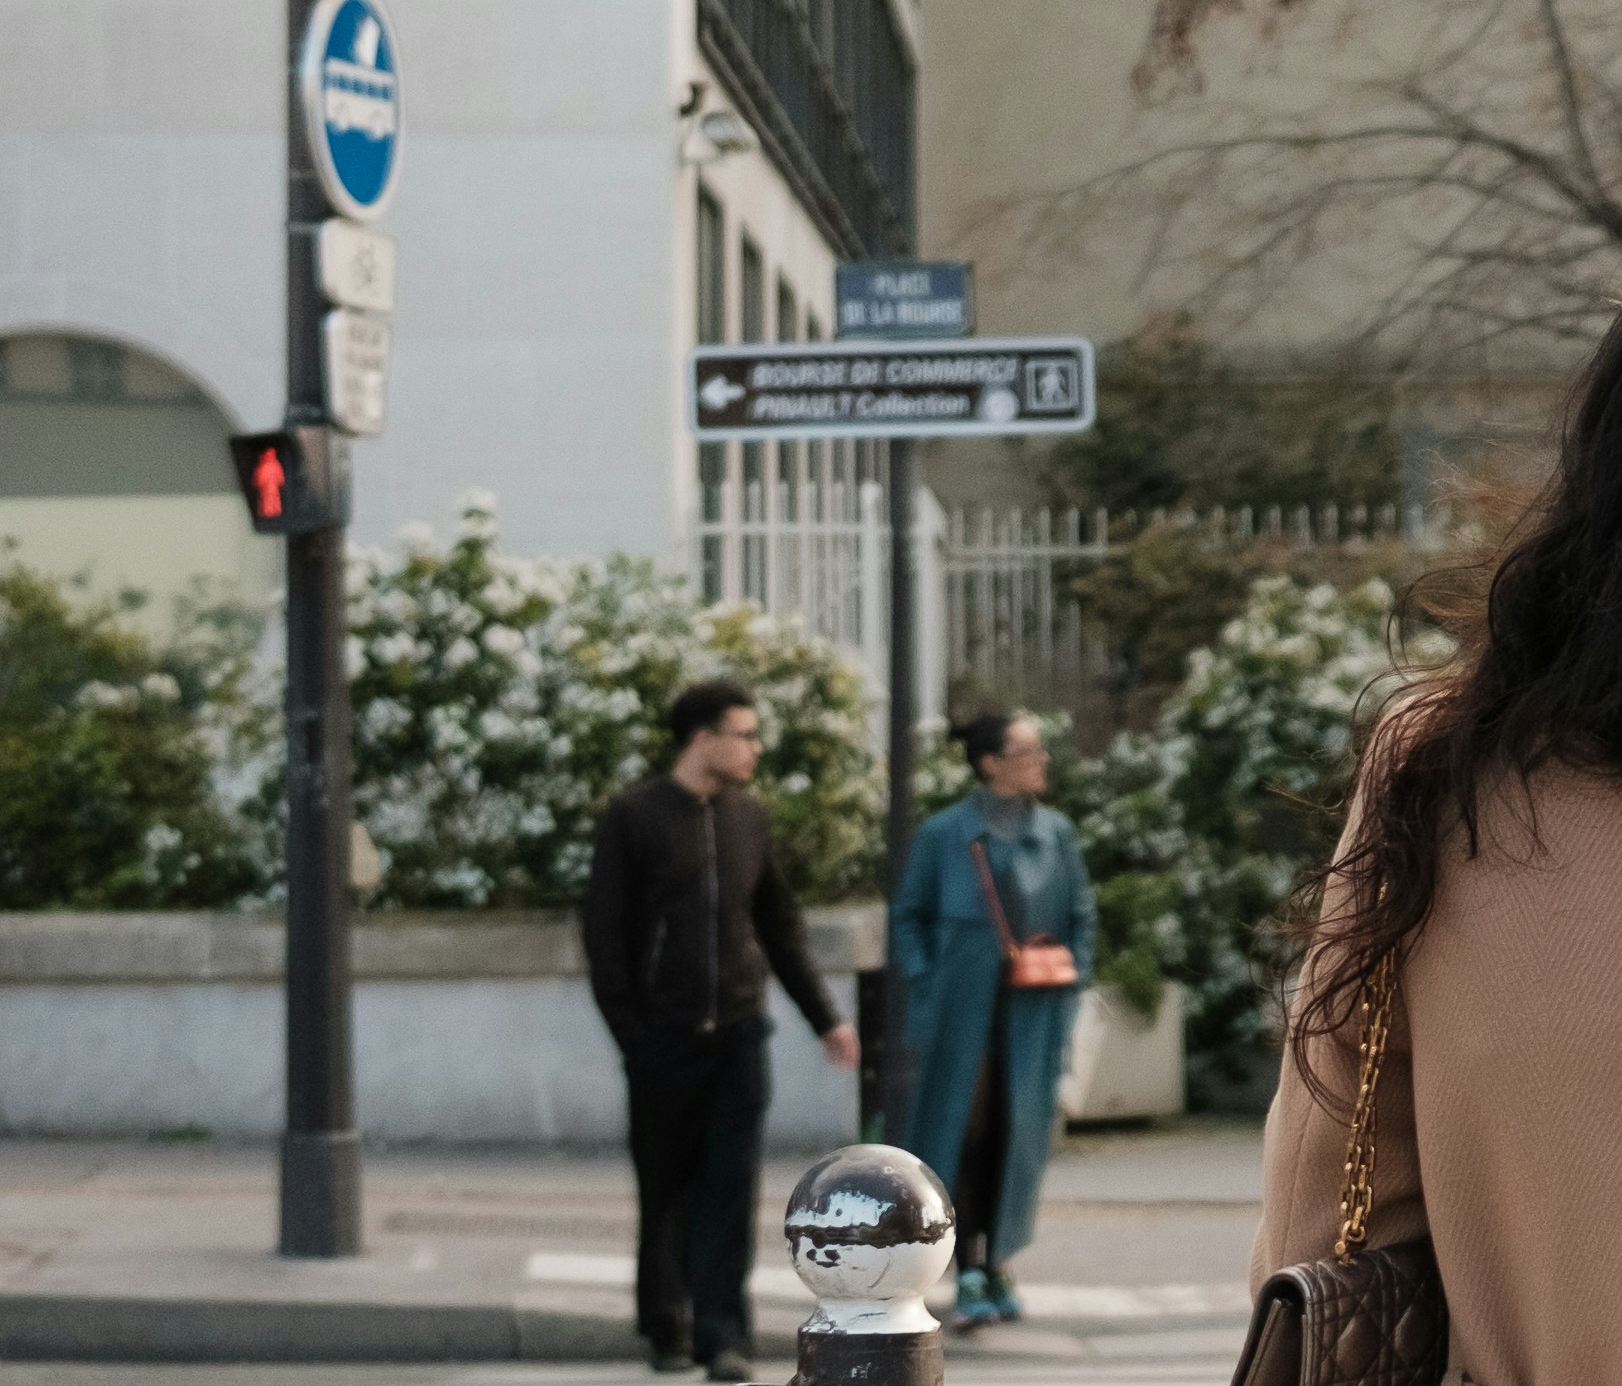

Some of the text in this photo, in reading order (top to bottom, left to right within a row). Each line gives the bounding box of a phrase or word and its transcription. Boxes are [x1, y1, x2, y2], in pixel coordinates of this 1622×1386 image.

[874, 273, 930, 296] PLACE
[870, 301, 893, 324] LA
[898, 300, 962, 324] BOURSE
[753, 357, 1017, 387] BOURSE DE COMMERCE
[753, 392, 971, 418] PINAULT Collection
